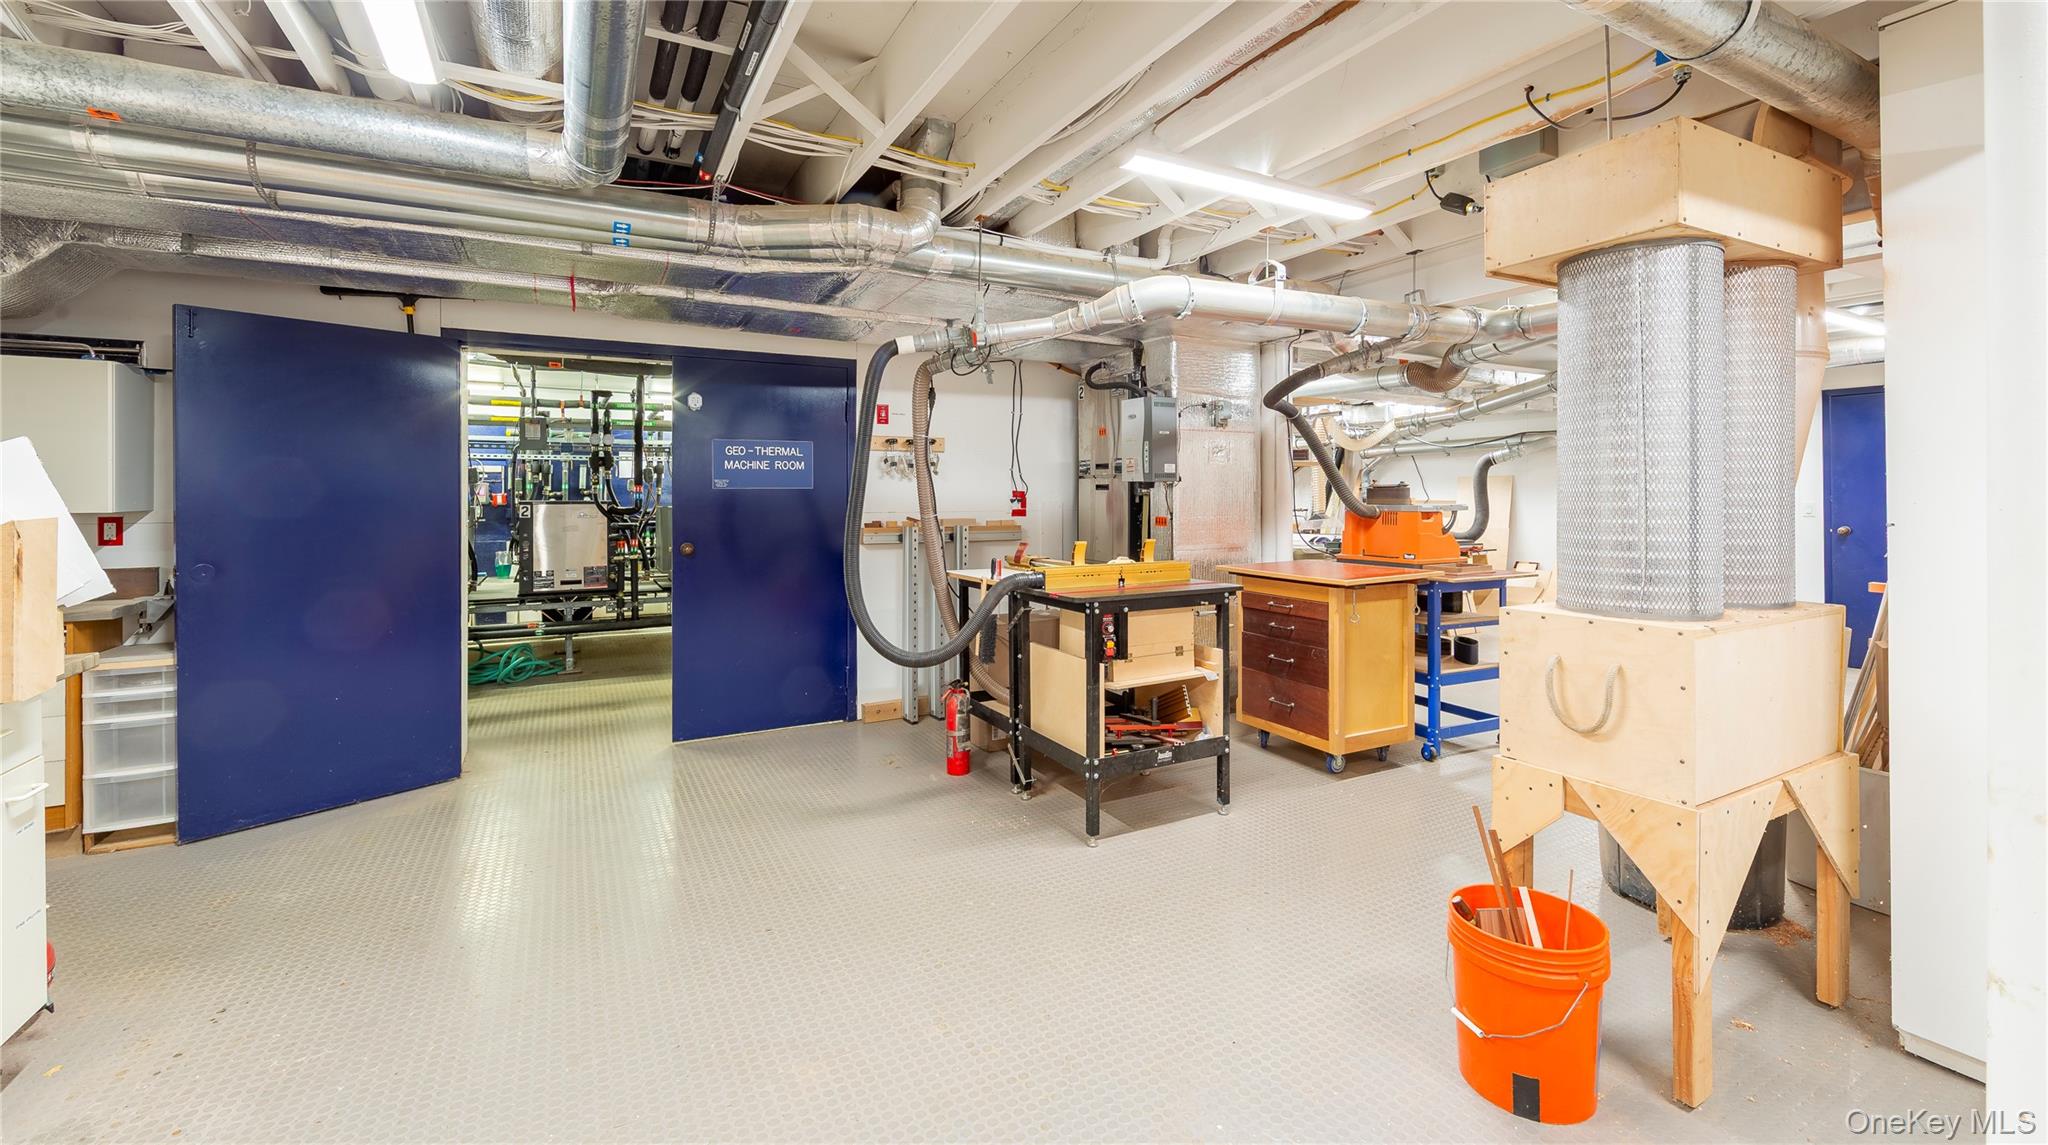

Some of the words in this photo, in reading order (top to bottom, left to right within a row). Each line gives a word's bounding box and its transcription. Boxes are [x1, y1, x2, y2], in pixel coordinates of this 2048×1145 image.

[1079, 387, 1084, 399] 2
[724, 460, 770, 470] MACHINE
[774, 461, 805, 470] ROOM
[521, 506, 529, 517] 2
